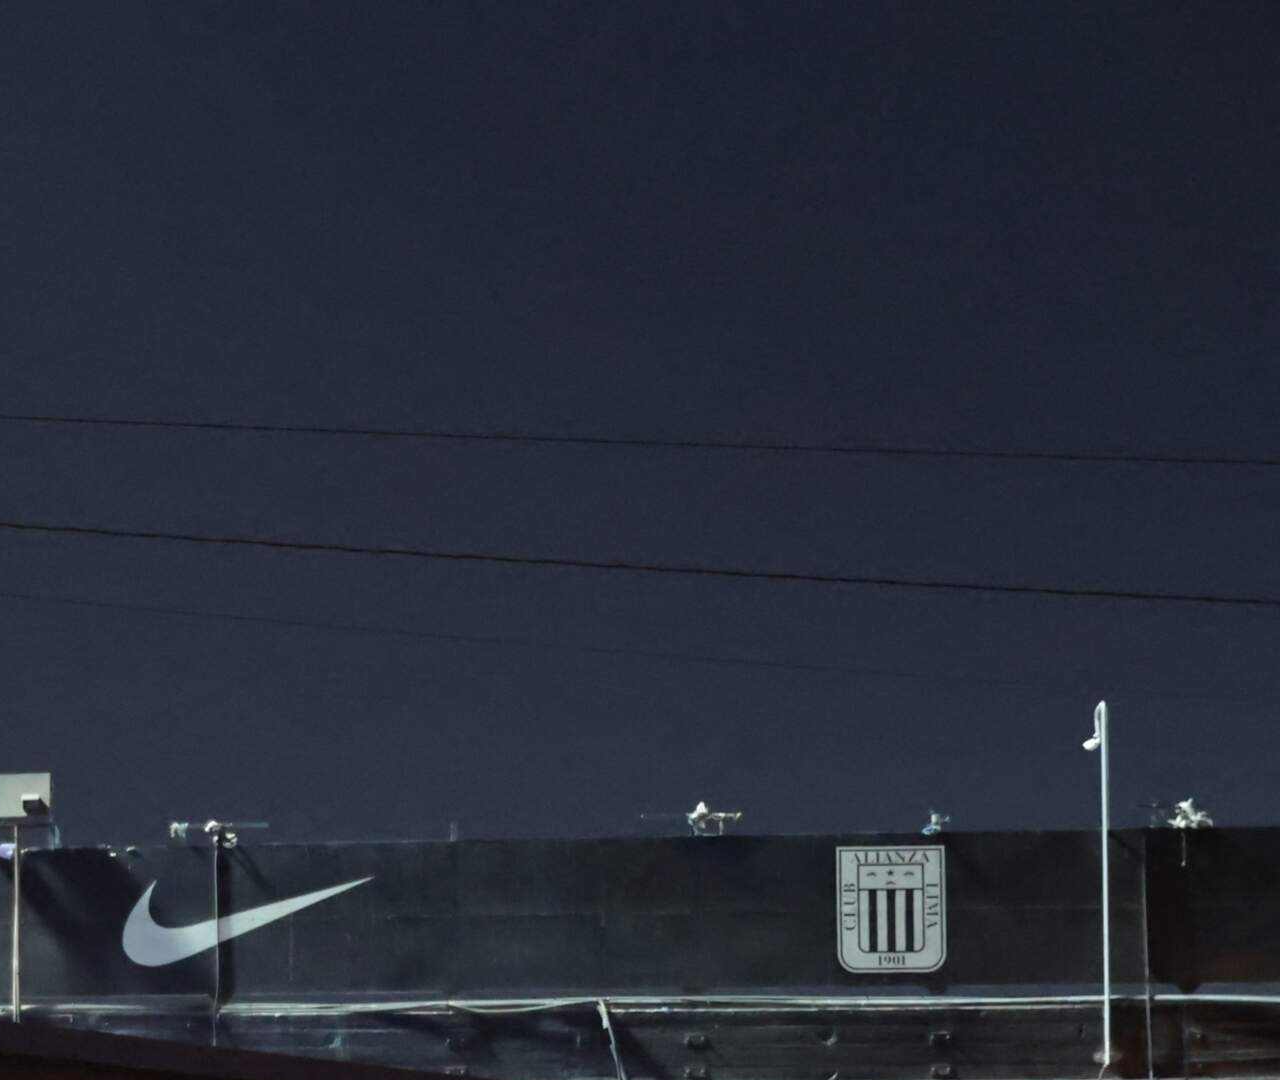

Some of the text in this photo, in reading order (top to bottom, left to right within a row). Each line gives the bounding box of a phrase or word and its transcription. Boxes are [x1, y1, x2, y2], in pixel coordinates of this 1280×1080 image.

[851, 851, 930, 863] ALIANZA
[843, 883, 856, 931] CLUB
[926, 883, 939, 929] LIMA
[878, 955, 907, 966] 1901
